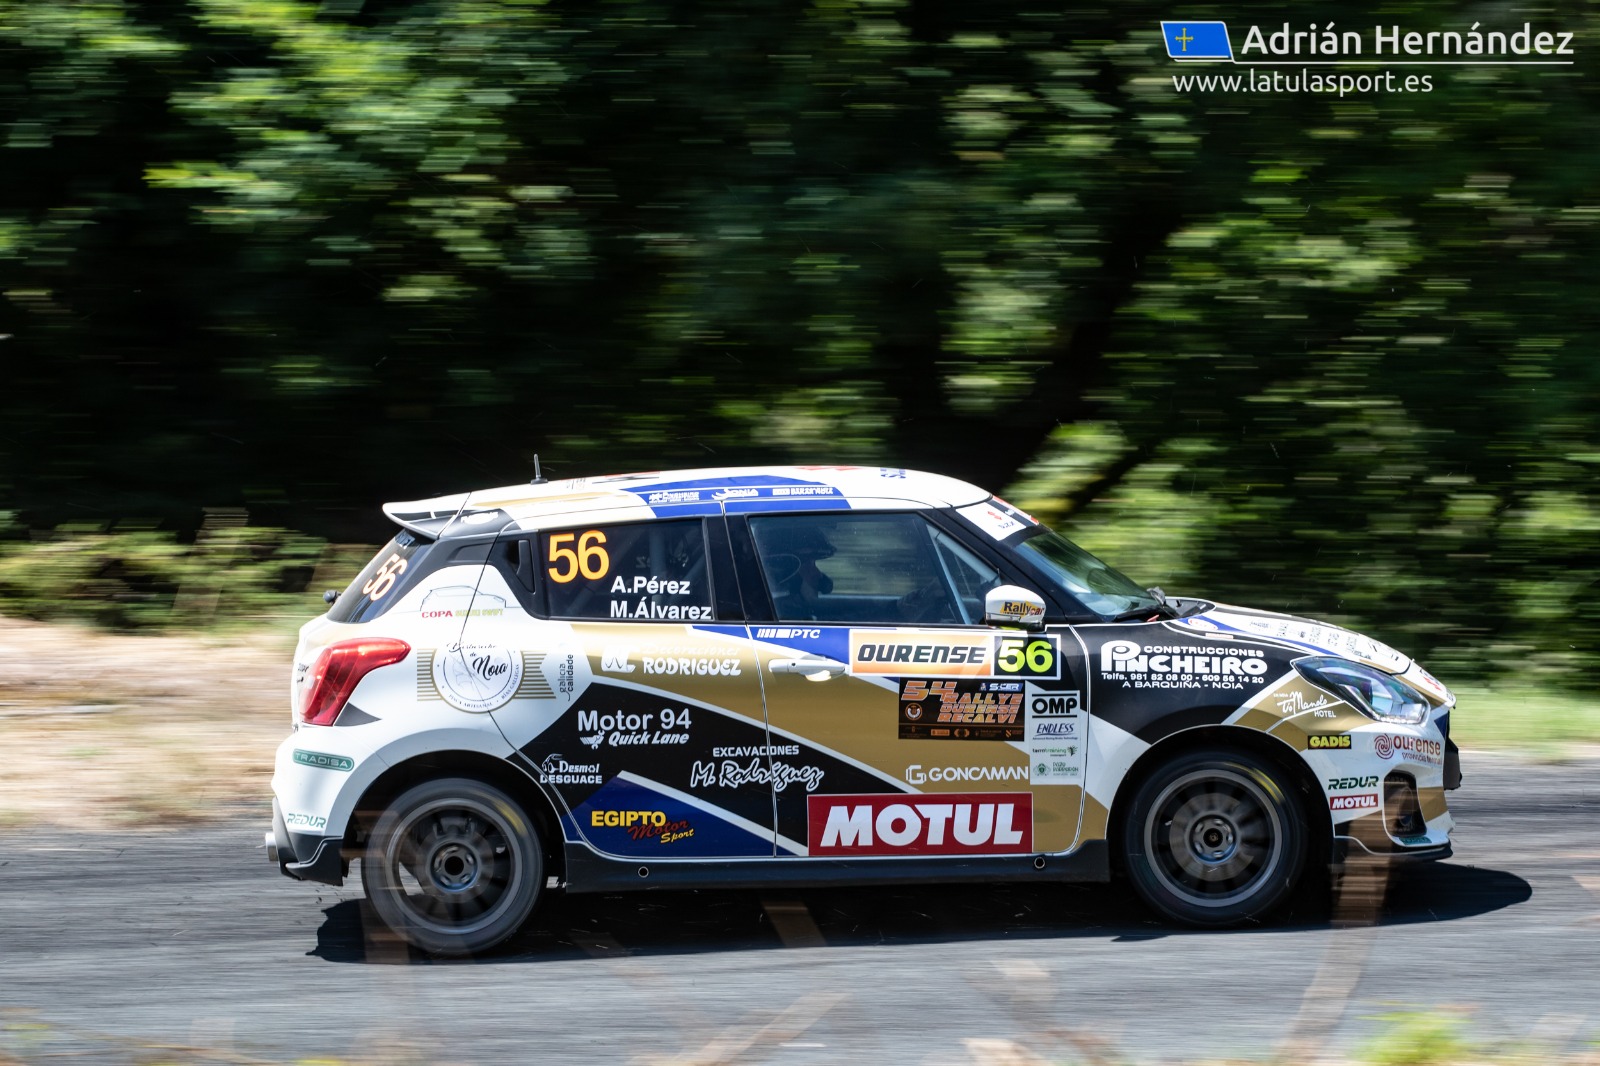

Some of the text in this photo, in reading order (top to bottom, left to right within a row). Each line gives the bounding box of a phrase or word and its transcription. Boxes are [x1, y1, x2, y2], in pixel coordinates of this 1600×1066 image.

[548, 529, 610, 584] 56
[362, 553, 408, 601] 56
[610, 576, 691, 595] A.Pérez
[421, 610, 453, 619] COPA
[610, 597, 712, 620] M.Álvarez
[790, 629, 821, 639] PTC
[857, 639, 1053, 673] OURENSE 56
[1101, 640, 1268, 675] PINCHEIRO
[1143, 645, 1264, 657] CONSTRUCCIONES
[566, 654, 574, 692] calidade
[642, 656, 741, 676] RODRIGUEZ
[1135, 680, 1201, 689] BARQUIÑA
[1212, 682, 1243, 690] NOIA
[1252, 676, 1264, 684] 20
[901, 680, 957, 701] 54
[943, 692, 1024, 704] RALLYE
[940, 704, 1019, 713] OURENSE
[1032, 697, 1077, 714] OMP
[577, 708, 692, 731] Motor 94
[937, 713, 1016, 723] RECALVI
[1314, 710, 1336, 718] HOTEL
[1037, 723, 1075, 734] ENDLESS
[608, 731, 690, 746] Quick Lane
[1310, 735, 1351, 748] GADIS
[1394, 735, 1440, 755] ourense
[712, 745, 800, 757] EXCAVACIONES
[295, 753, 348, 768] TRADISA
[559, 762, 600, 773] Desmol
[540, 774, 603, 784] DESGUACE
[690, 760, 715, 788] M.
[928, 765, 1029, 782] GONCAMAN
[1328, 776, 1379, 790] REDUR
[1332, 796, 1377, 809] MOTUL
[287, 813, 326, 829] REDUR
[591, 810, 666, 827] EGIPTO
[820, 803, 1023, 847] MOTUL
[627, 820, 690, 840] Motor
[660, 828, 694, 844] Sport
